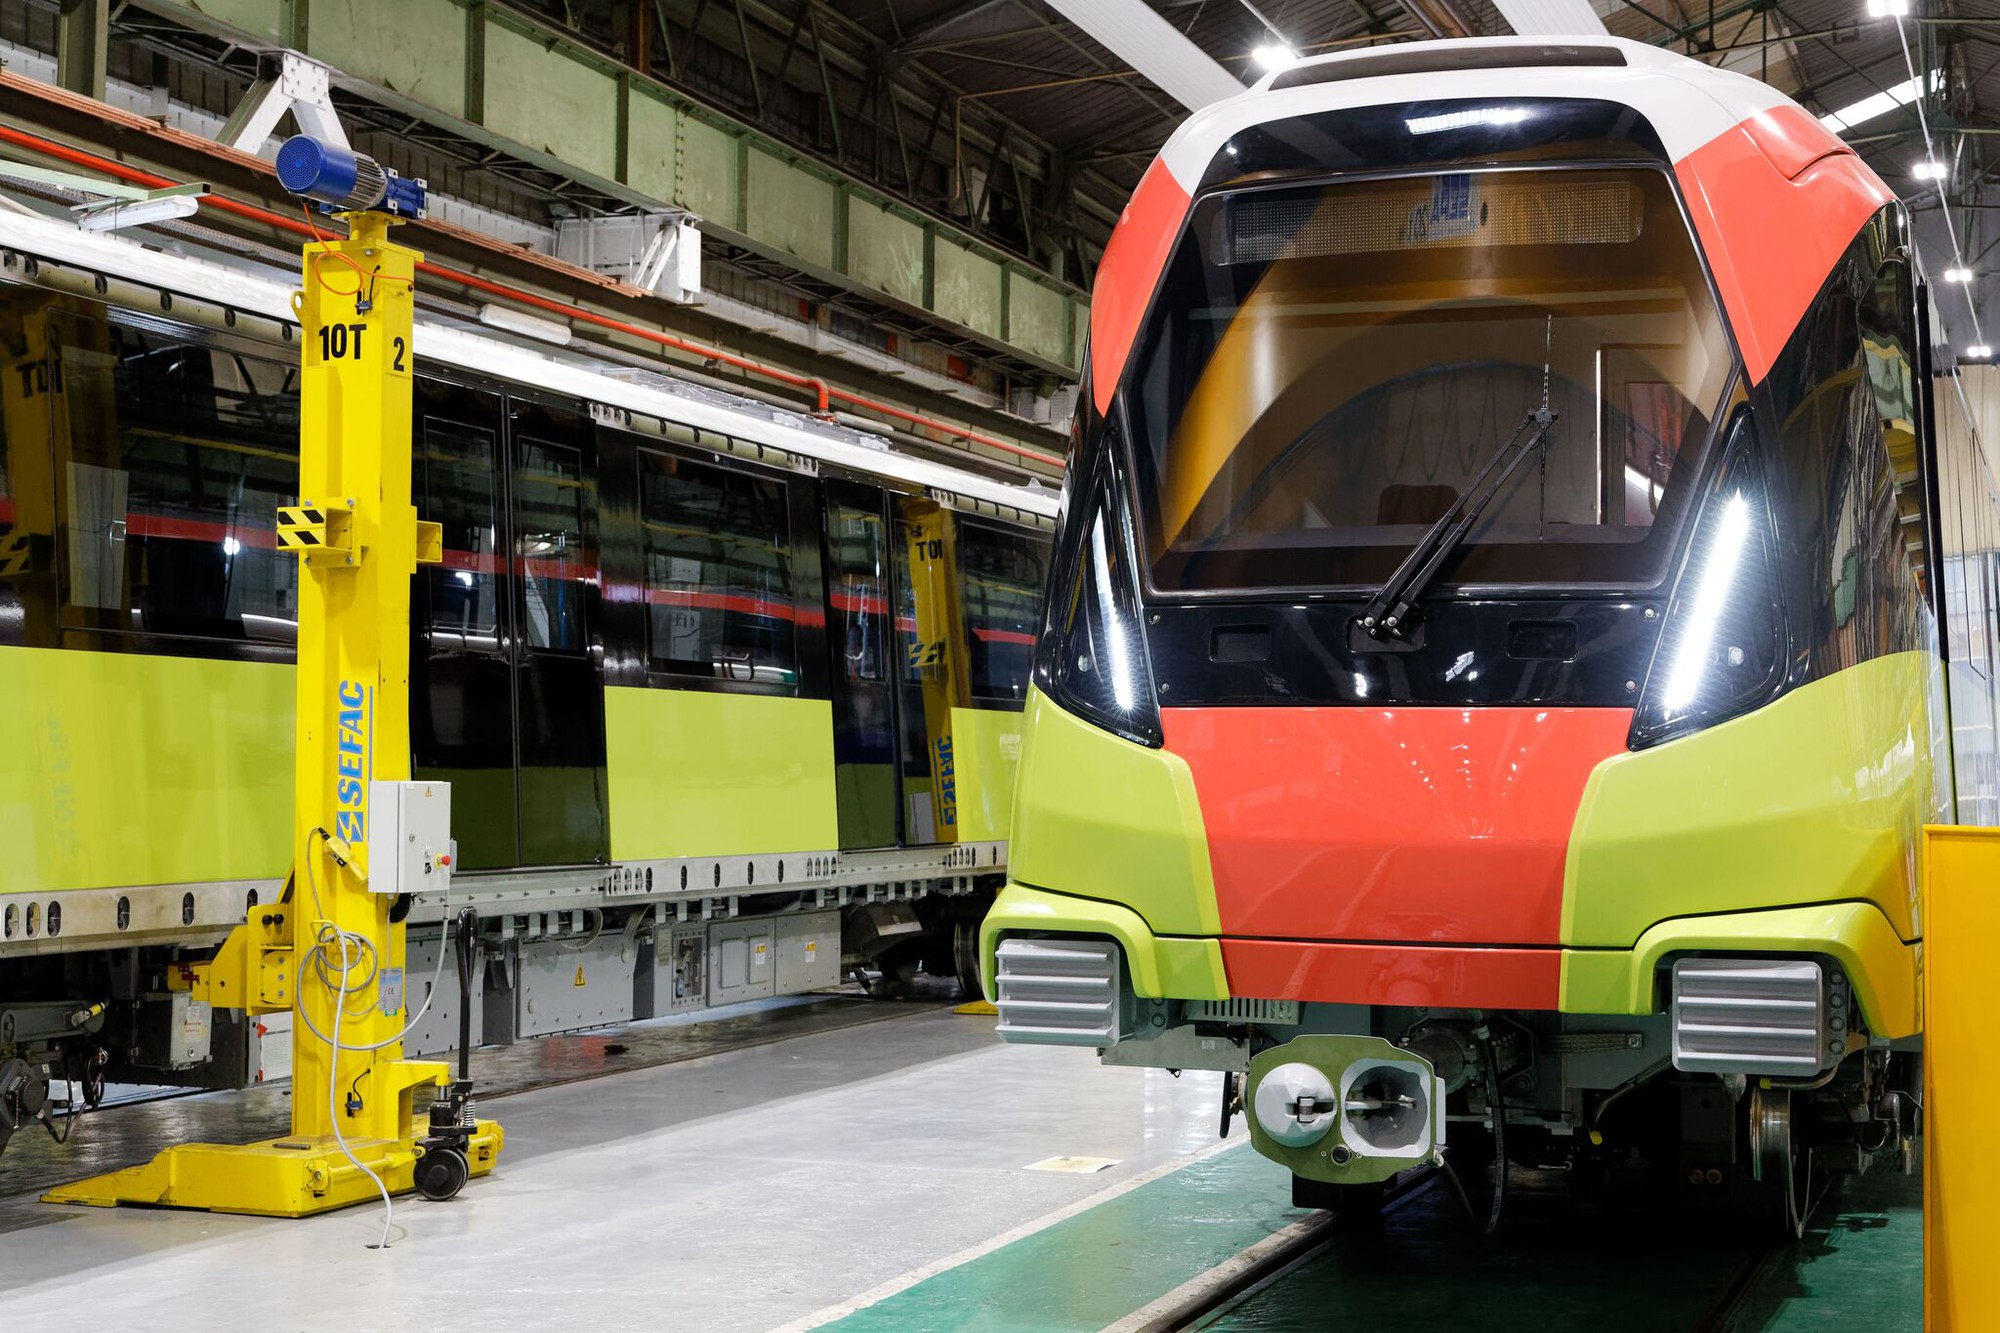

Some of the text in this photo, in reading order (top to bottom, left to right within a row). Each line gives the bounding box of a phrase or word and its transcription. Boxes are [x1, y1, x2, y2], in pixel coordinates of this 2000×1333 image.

[319, 323, 367, 361] 10T
[393, 336, 405, 372] 2
[337, 680, 365, 807] SEFAC
